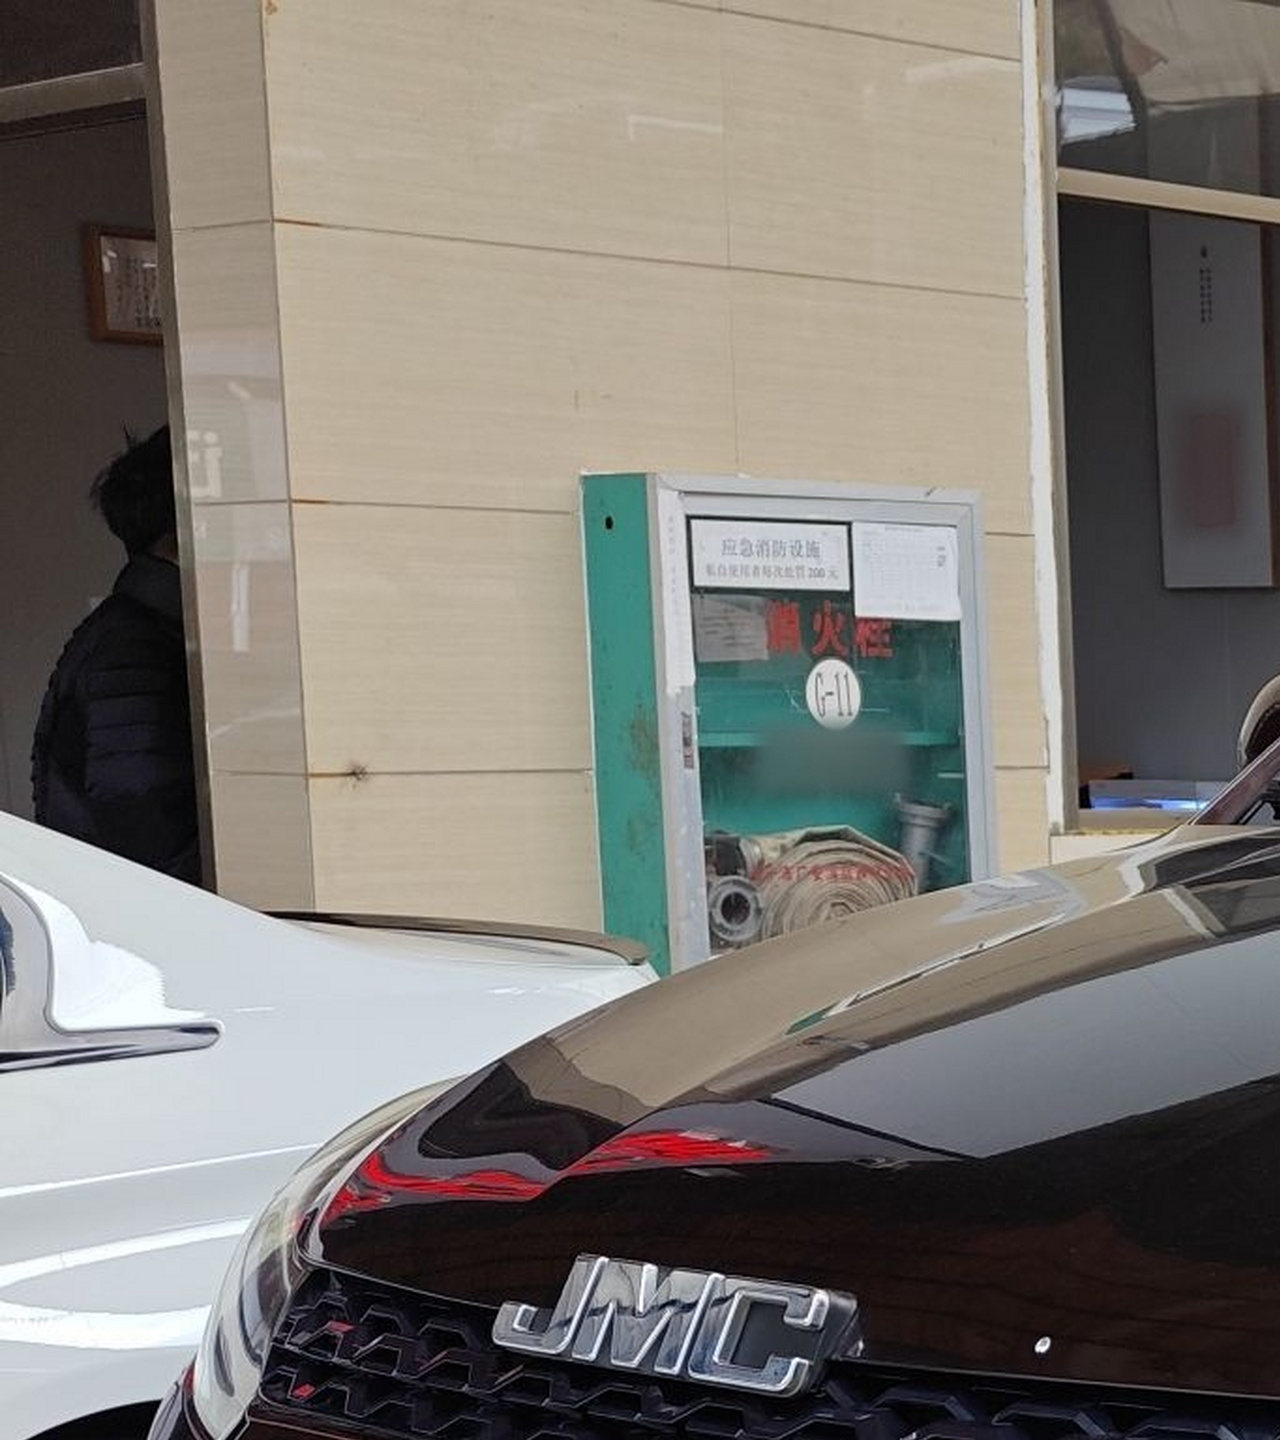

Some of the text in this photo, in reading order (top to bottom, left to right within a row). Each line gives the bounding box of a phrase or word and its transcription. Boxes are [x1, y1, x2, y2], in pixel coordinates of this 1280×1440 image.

[721, 538, 821, 558] 应急消防设施
[491, 1253, 858, 1398] JMC
